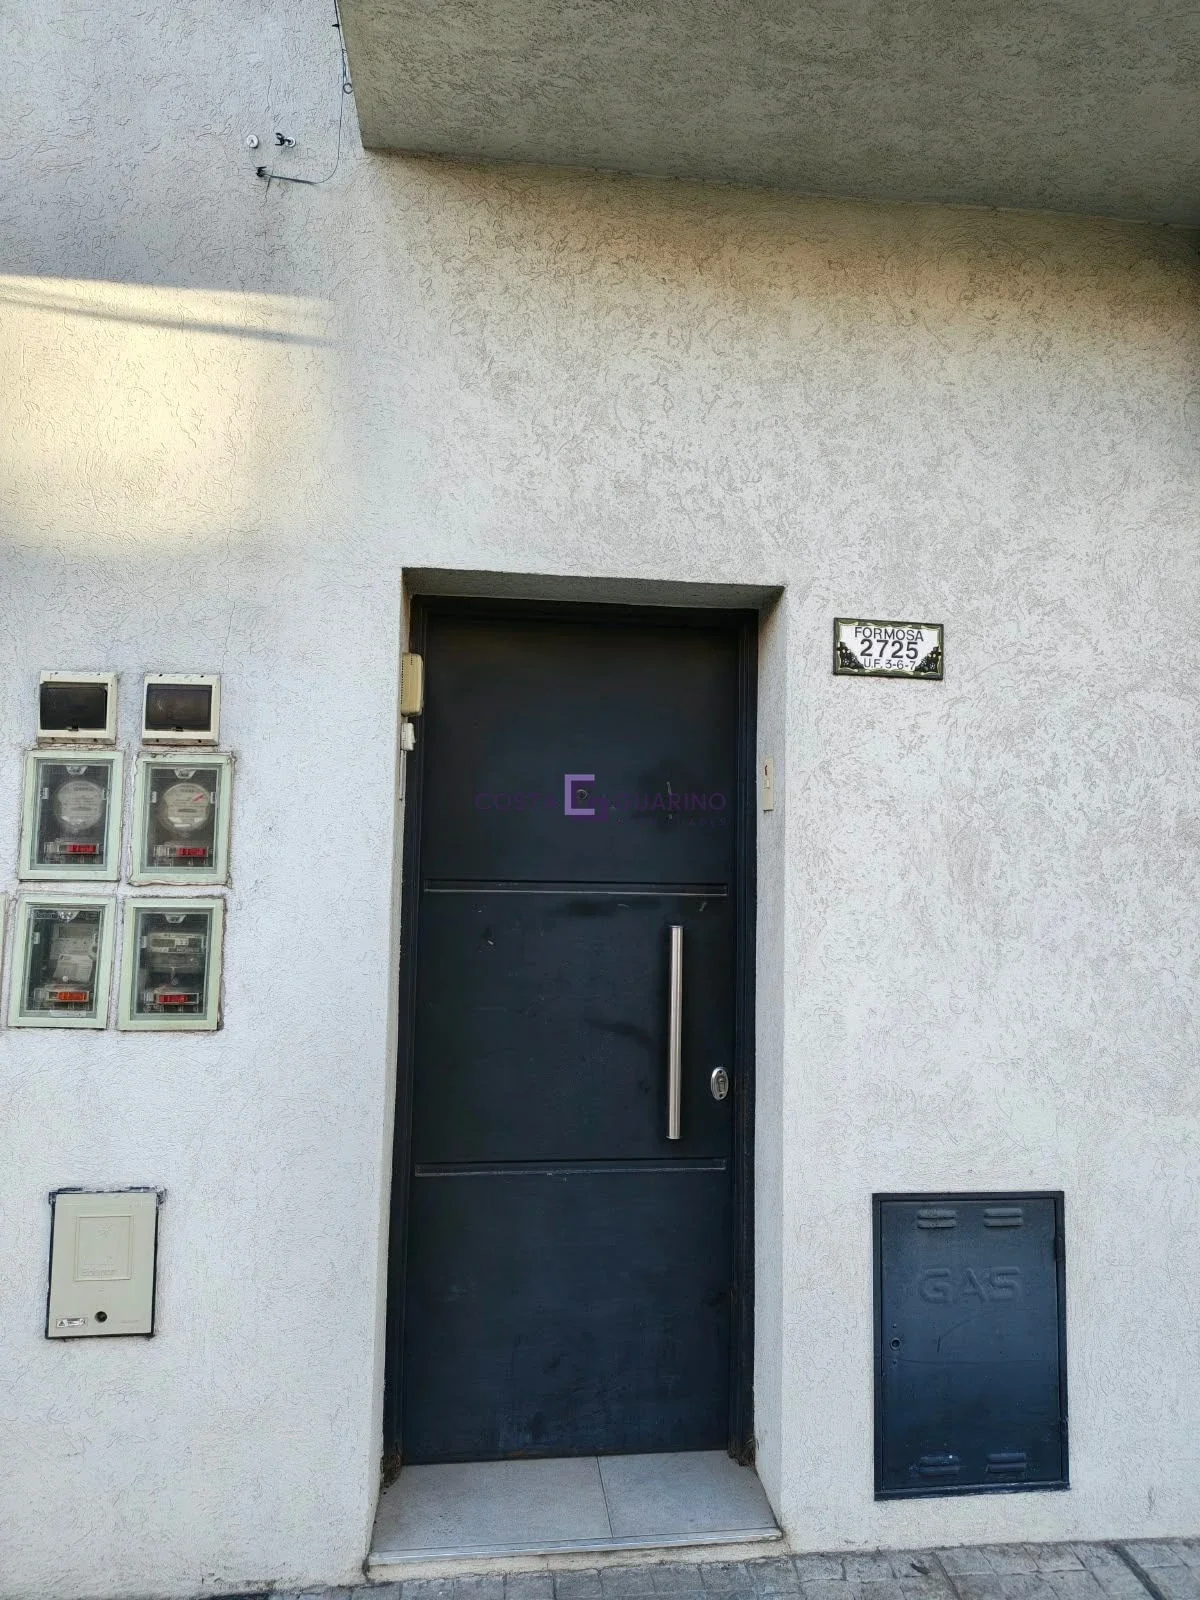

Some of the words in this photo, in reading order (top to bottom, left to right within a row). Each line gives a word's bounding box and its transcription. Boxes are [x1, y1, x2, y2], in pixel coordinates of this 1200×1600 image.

[854, 626, 924, 642] FORMOSA
[860, 638, 919, 660] 2725
[885, 660, 916, 671] 3-6-7
[919, 1265, 1024, 1305] GAS
